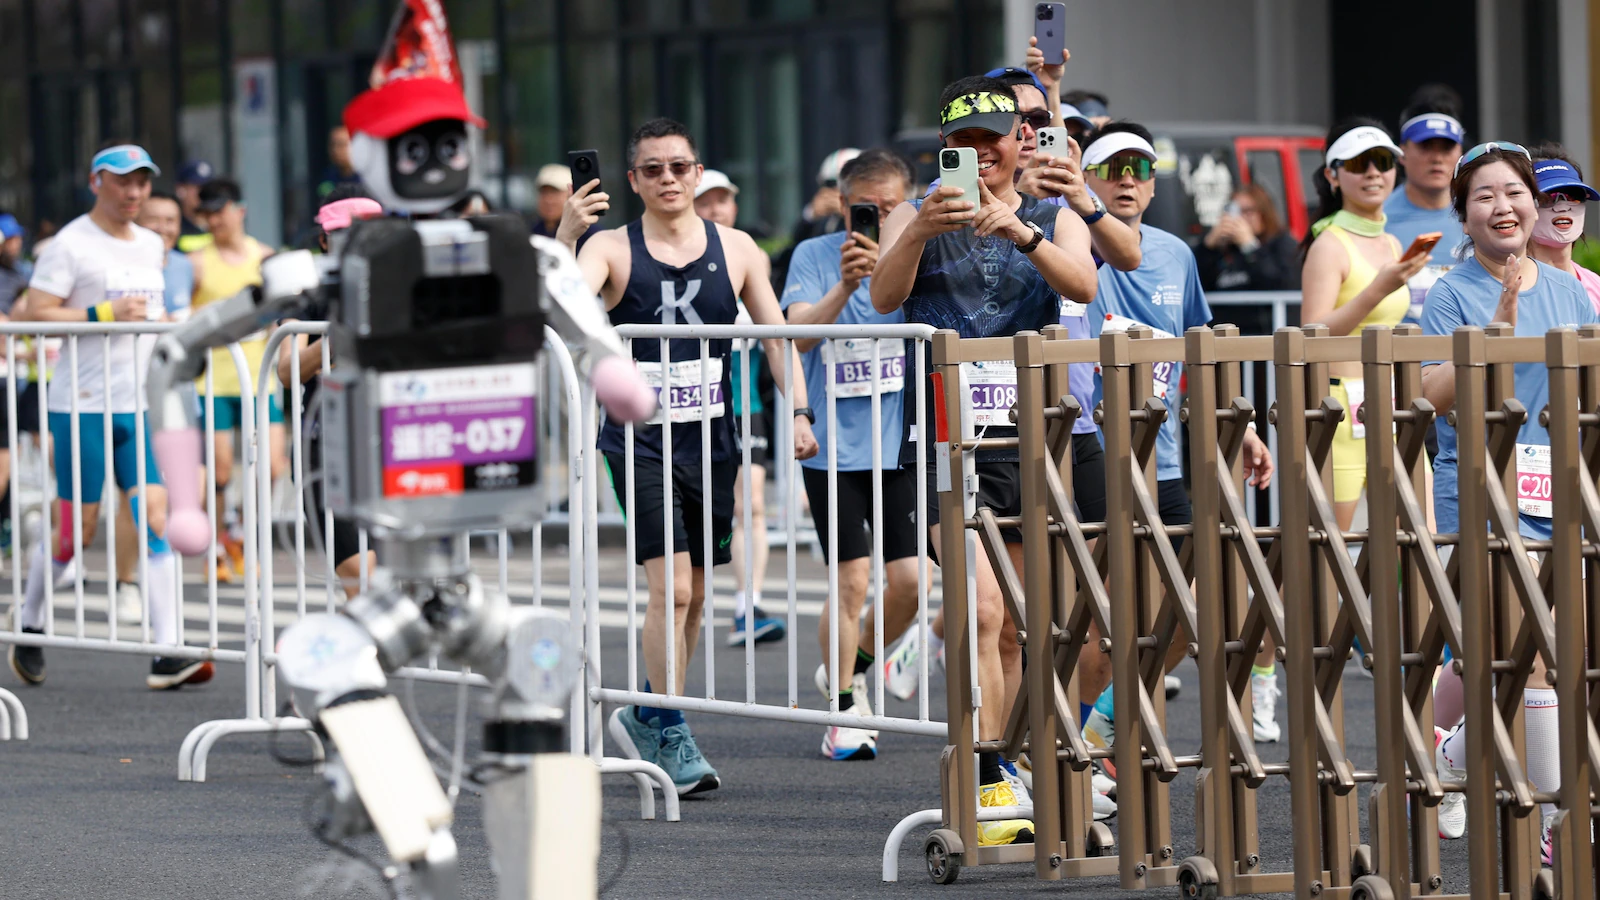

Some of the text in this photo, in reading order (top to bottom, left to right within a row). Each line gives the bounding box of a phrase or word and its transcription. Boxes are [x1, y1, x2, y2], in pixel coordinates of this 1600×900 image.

[983, 246, 1000, 315] NEDAO
[654, 279, 704, 324] K
[844, 358, 903, 382] B1376
[1153, 362, 1171, 382] 42
[658, 384, 720, 407] 1347
[970, 386, 1016, 408] C108
[1517, 475, 1552, 498] C20
